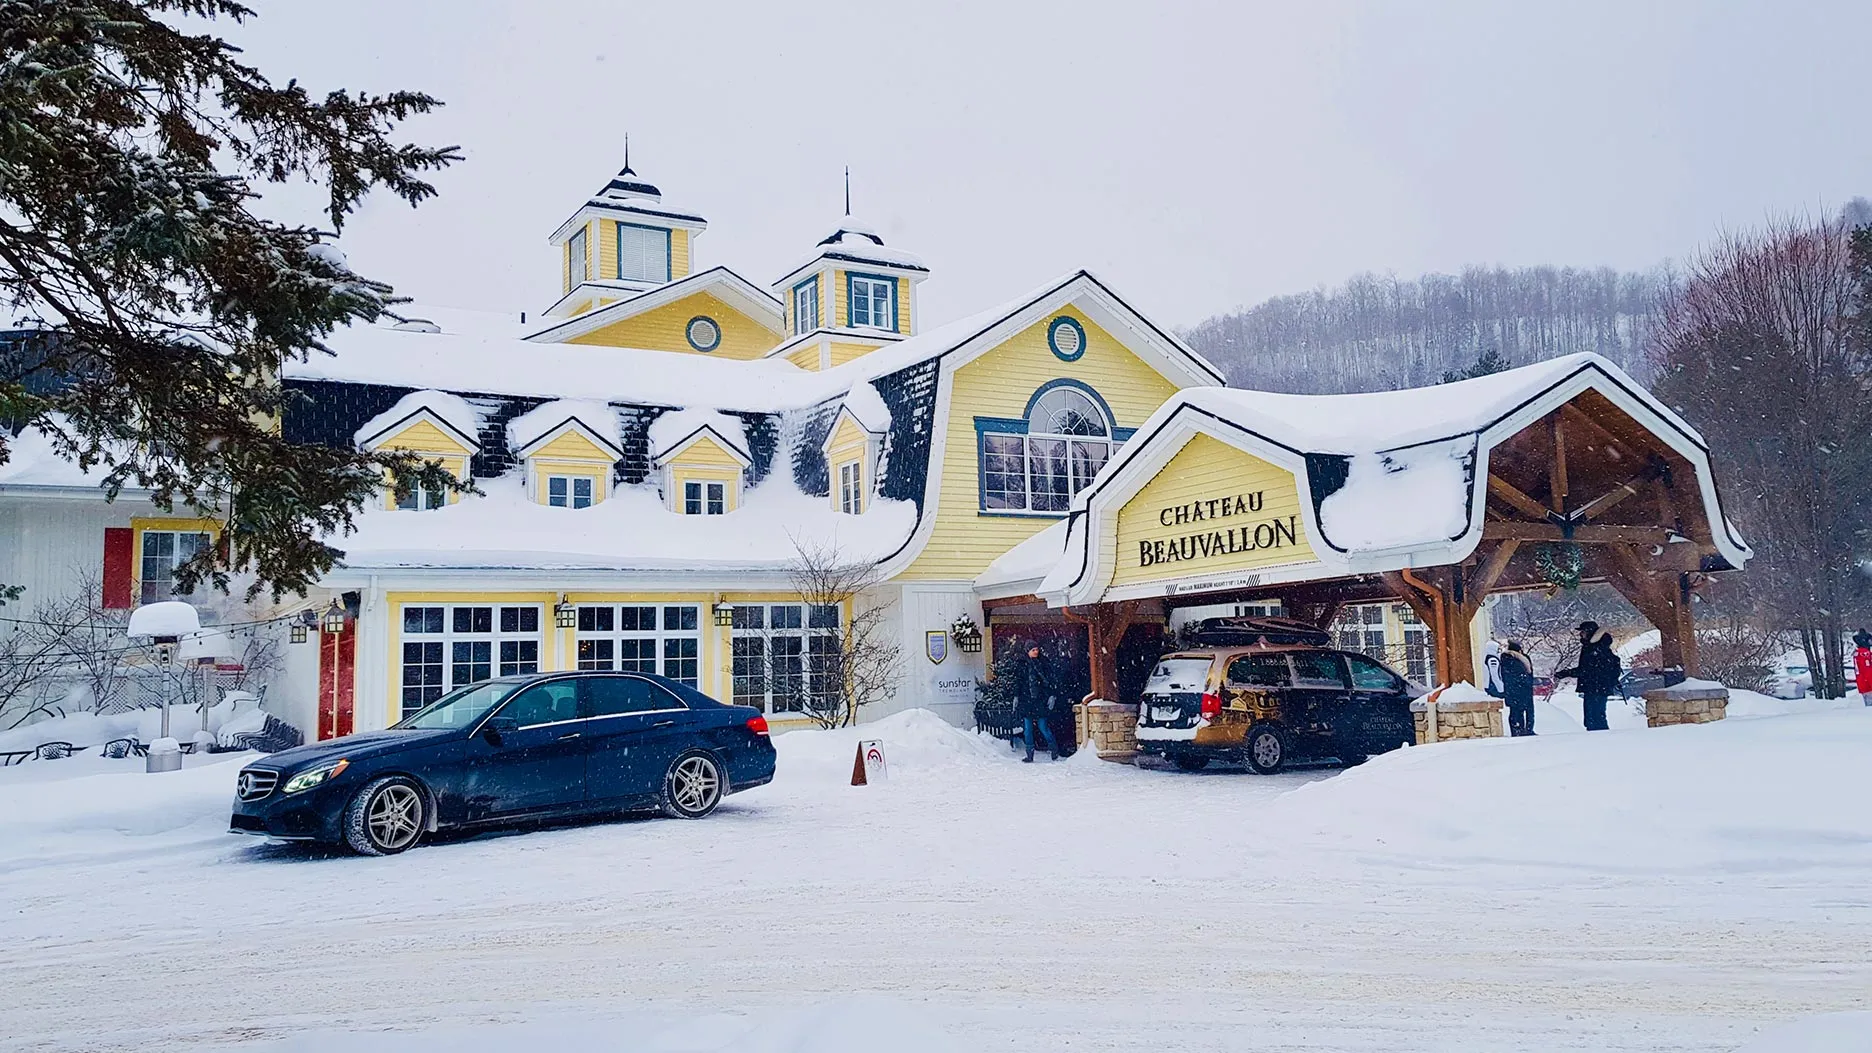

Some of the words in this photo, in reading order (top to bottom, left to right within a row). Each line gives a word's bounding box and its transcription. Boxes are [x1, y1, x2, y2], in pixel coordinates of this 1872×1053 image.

[1160, 491, 1264, 527] CHÂTEAU
[1139, 516, 1297, 567] BEAUVALLON
[938, 677, 971, 688] sunstar
